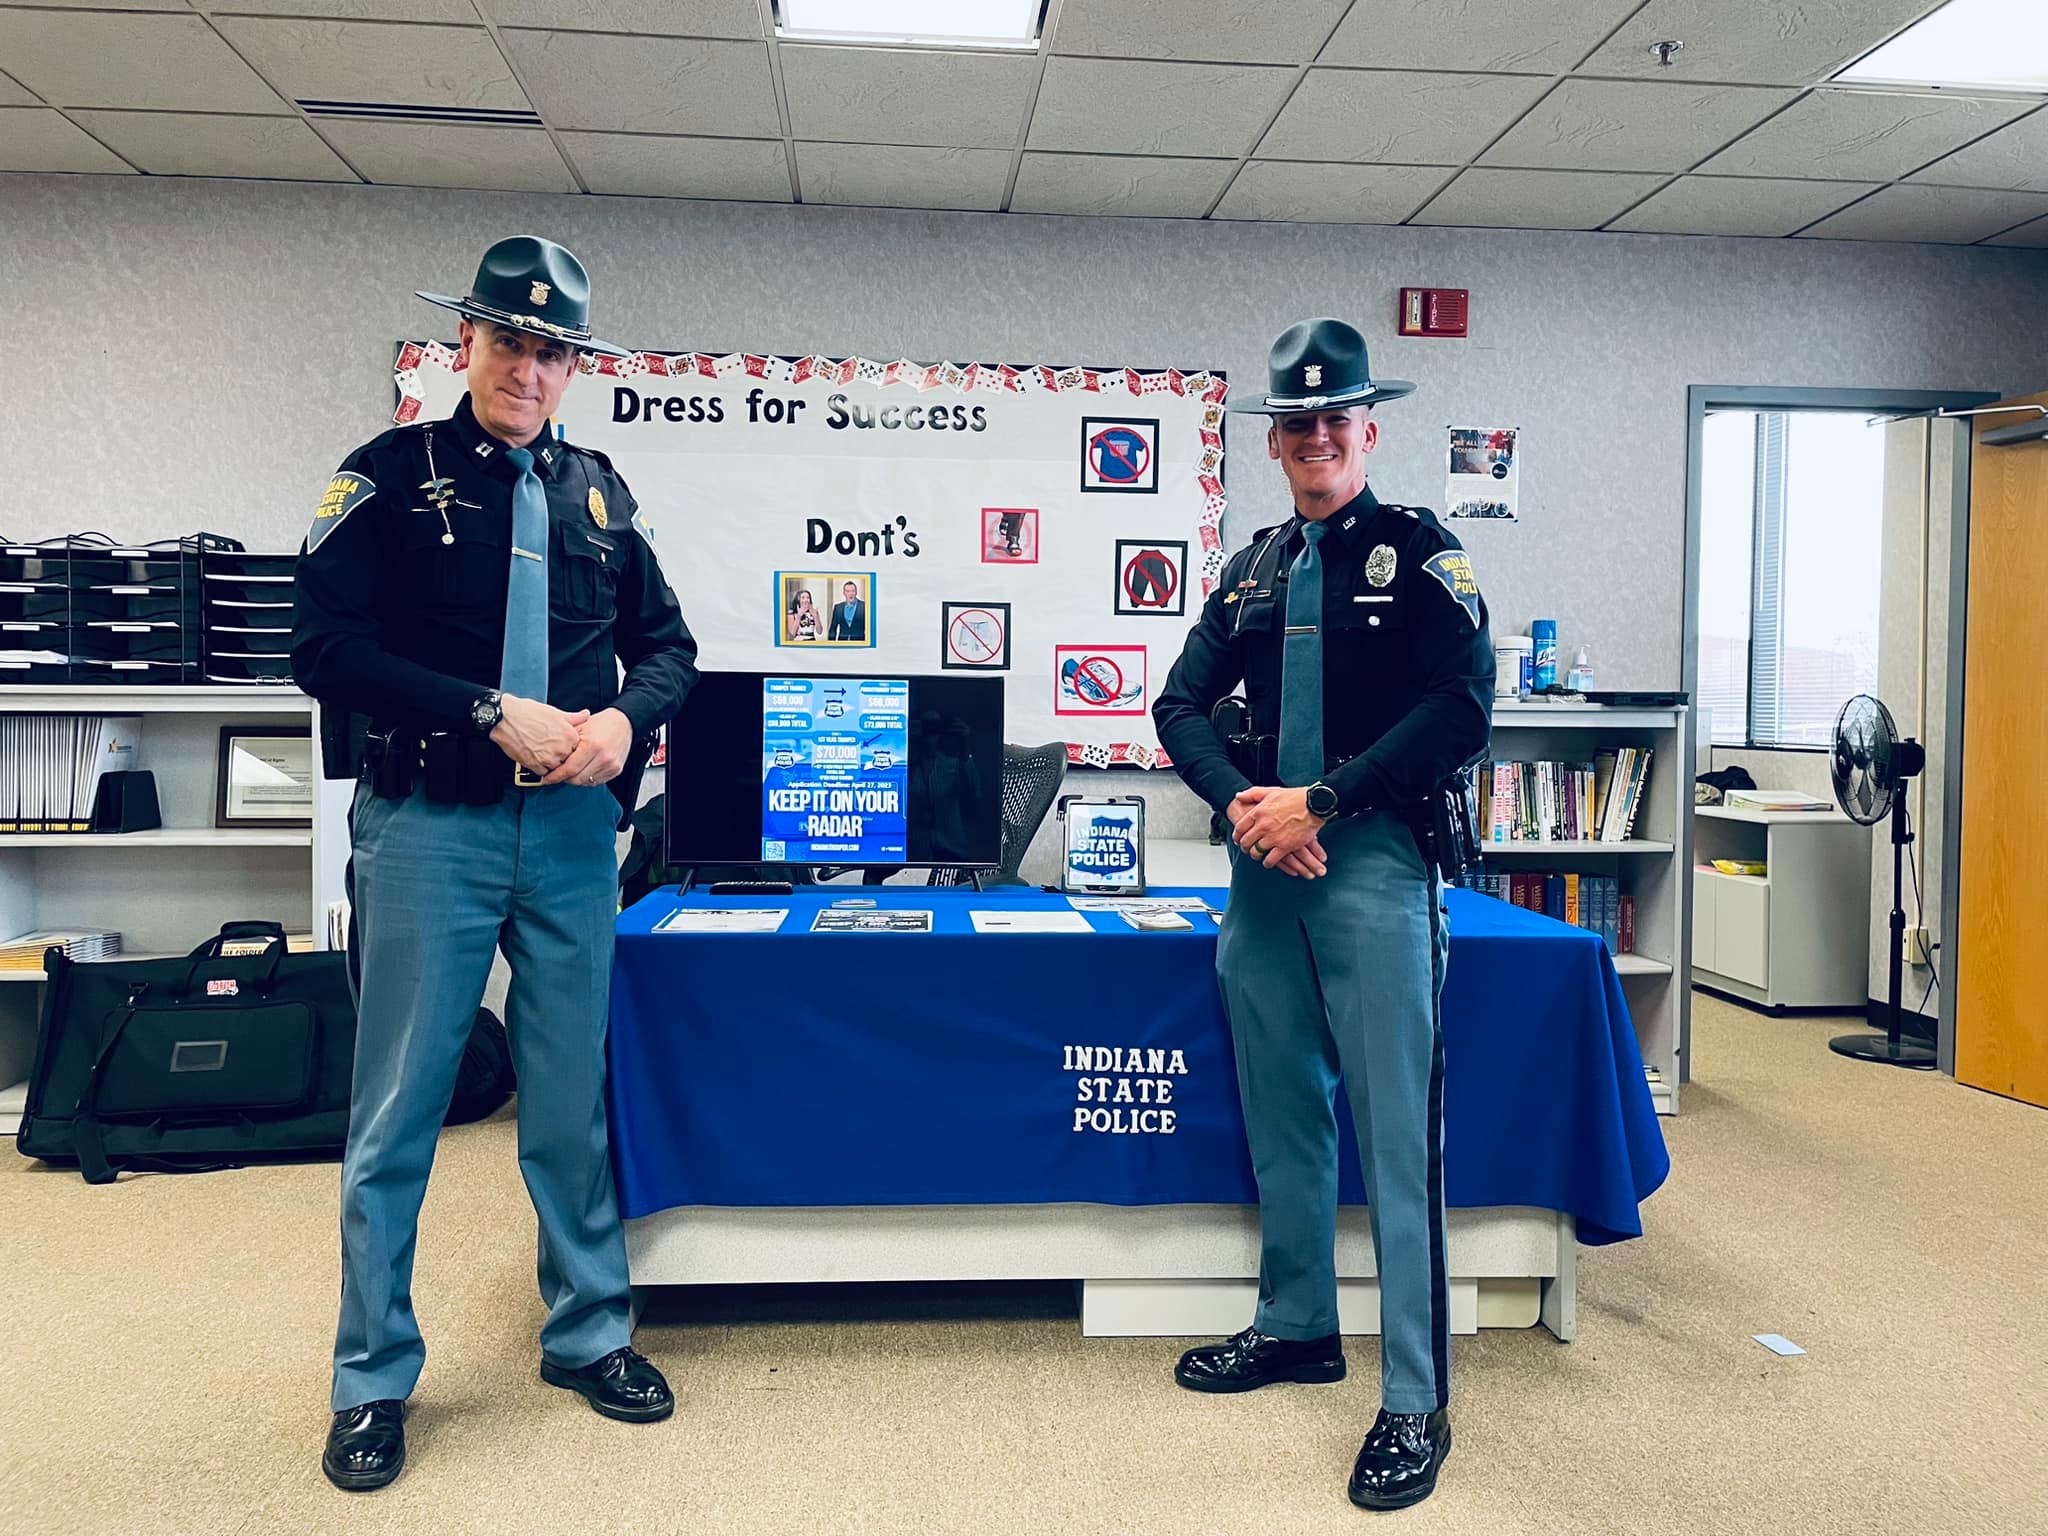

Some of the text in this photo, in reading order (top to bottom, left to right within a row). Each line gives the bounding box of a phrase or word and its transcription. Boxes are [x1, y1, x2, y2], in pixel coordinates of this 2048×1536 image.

[612, 386, 988, 433] Dress for Success
[806, 515, 921, 558] Dont's
[816, 746, 857, 760] $70,000
[768, 789, 899, 813] KEEP IT ON YOUR
[807, 815, 863, 837] RADAR
[1076, 826, 1129, 840] INDIANA
[1077, 838, 1126, 852] STATE
[1071, 852, 1130, 867] POLICE
[1063, 1045, 1189, 1075] INDIANA
[1077, 1076, 1174, 1105] STATE
[1072, 1107, 1177, 1134] POLICE
